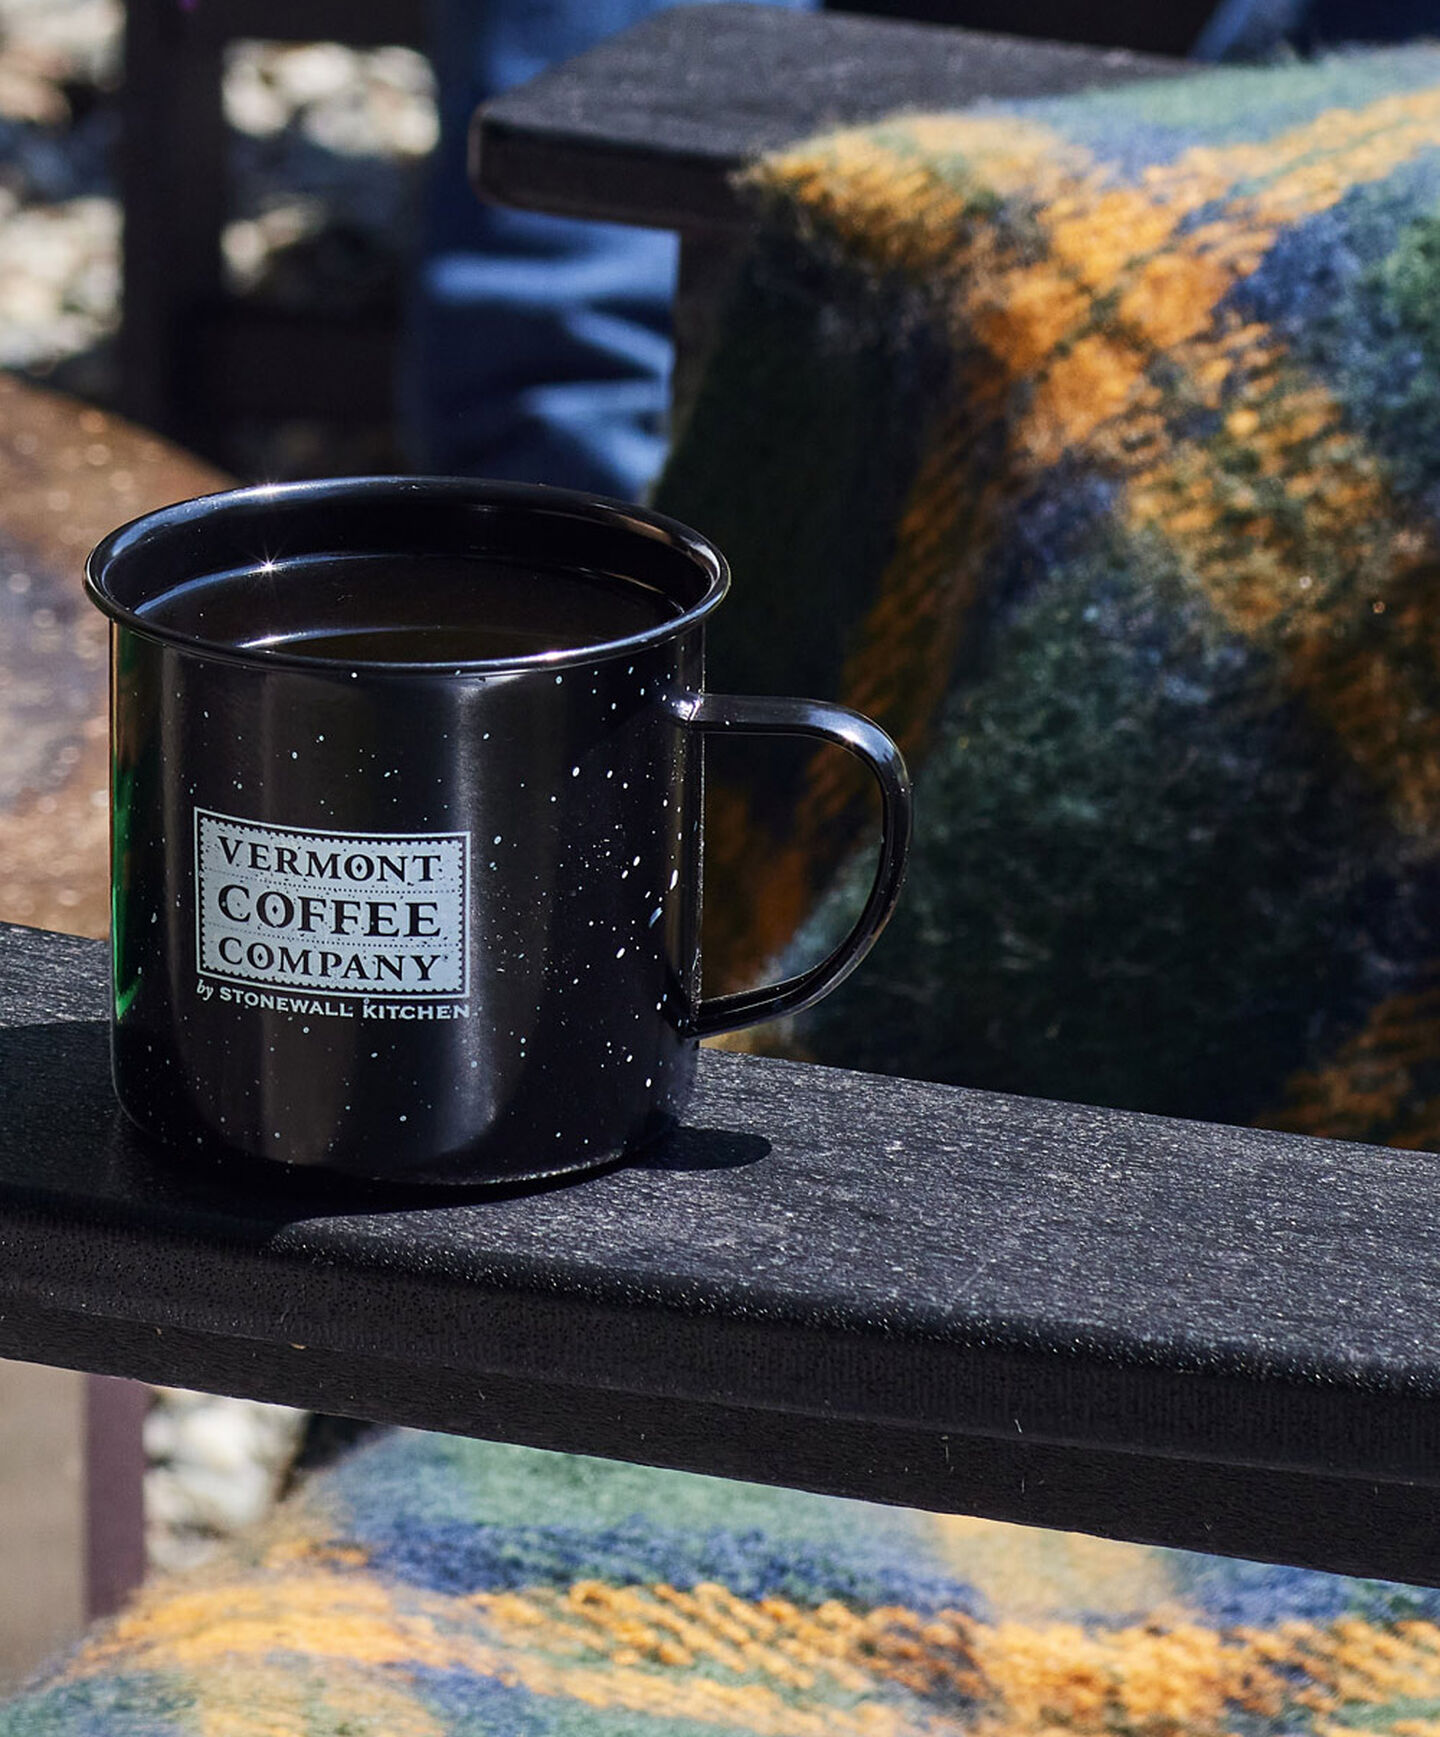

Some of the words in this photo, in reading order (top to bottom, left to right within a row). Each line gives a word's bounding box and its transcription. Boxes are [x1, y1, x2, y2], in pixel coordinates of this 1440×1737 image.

[216, 835, 442, 883] VERMONT
[217, 883, 442, 938] COFFEE
[217, 936, 442, 982] COMPANY
[195, 979, 215, 1002] by
[219, 986, 354, 1018] STONEWALL
[362, 1004, 470, 1021] KITCHEN
